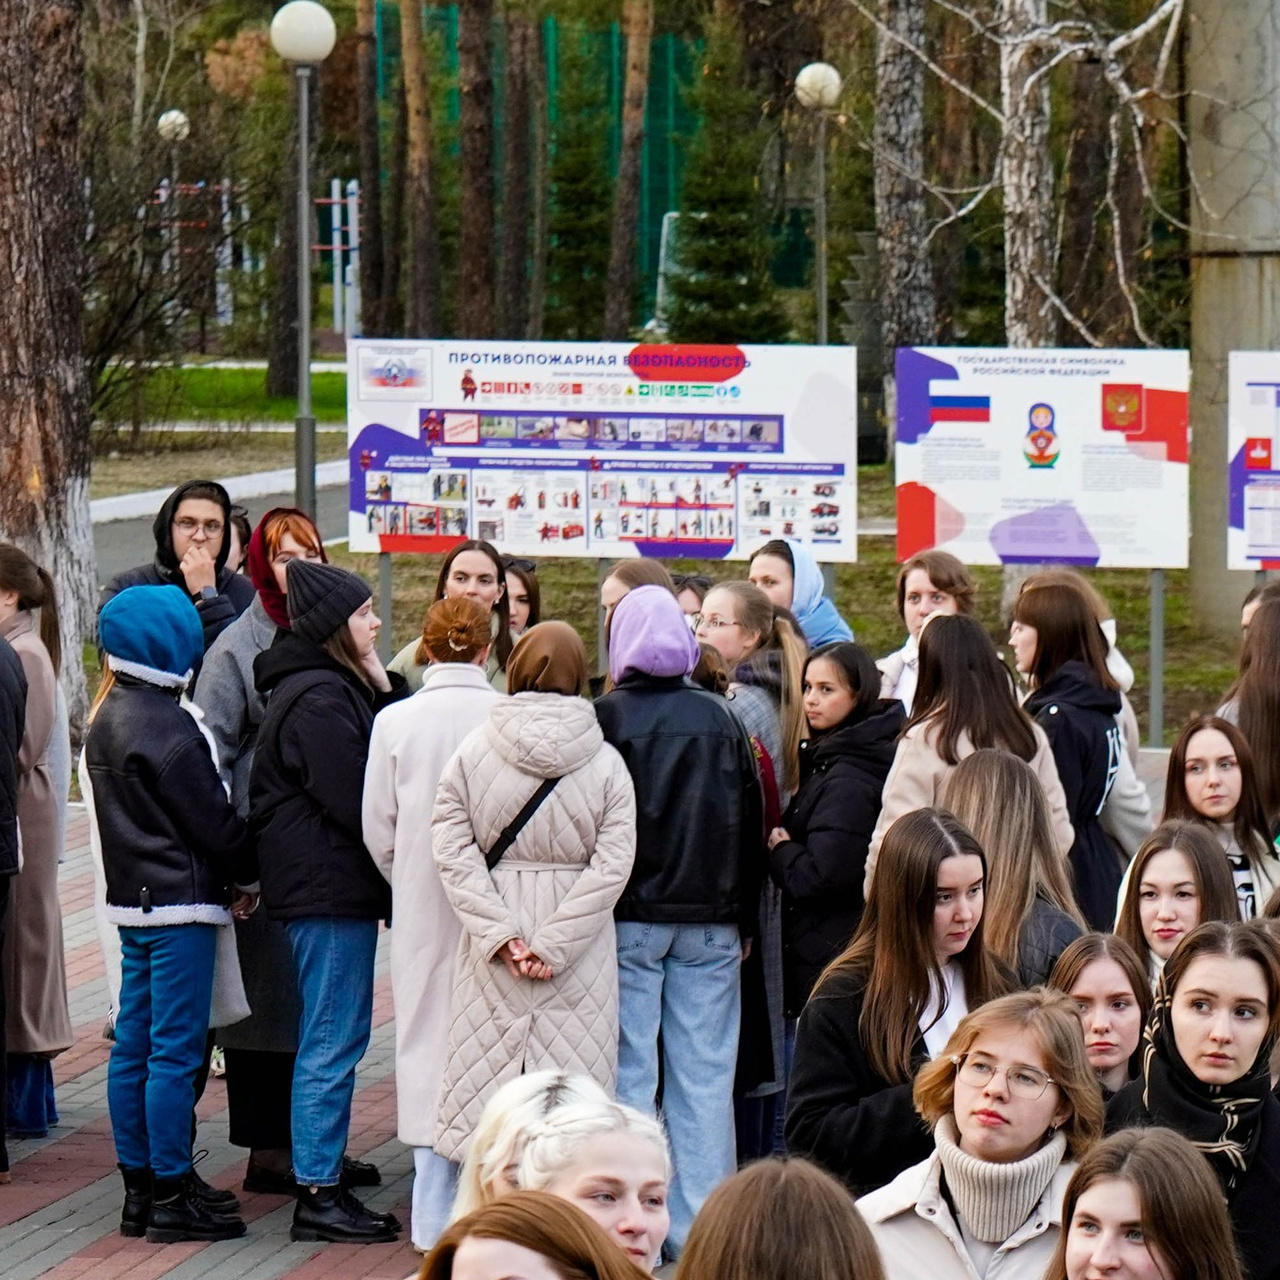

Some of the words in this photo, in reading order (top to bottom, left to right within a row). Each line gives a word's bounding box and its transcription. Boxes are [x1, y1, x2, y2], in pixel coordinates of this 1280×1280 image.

[449, 352, 617, 366] ПРОТИВОПОЖАРНАЯ
[623, 354, 751, 368] БЕЗОПАСНОСТЬ
[957, 355, 1057, 366] ГОСУДАРСТВЕННАЯ
[1060, 357, 1126, 366] СИМВОЛИКА
[972, 366, 1045, 375] РОССИЙСКОЙ
[1049, 367, 1110, 376] ФЕДЕРАЦИИ
